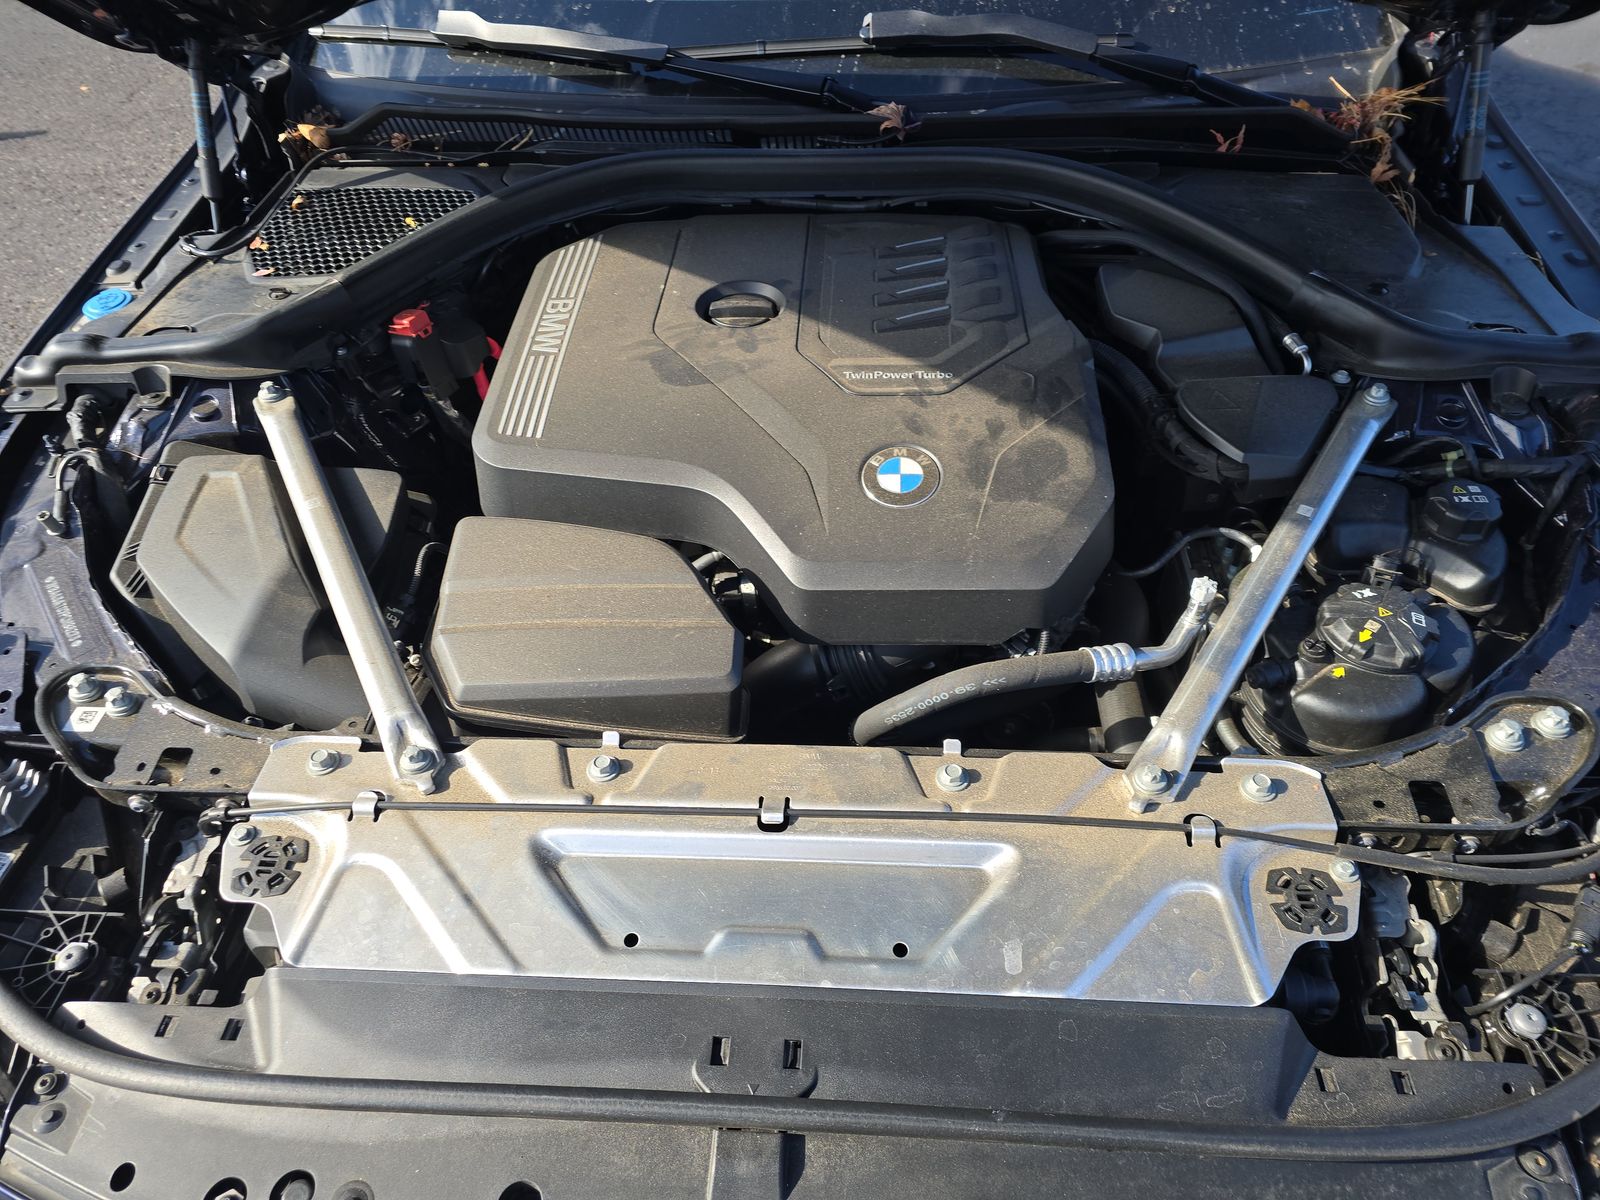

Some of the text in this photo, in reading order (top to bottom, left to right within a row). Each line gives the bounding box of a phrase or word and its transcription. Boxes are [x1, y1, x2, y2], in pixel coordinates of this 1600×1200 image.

[532, 299, 575, 353] BMW
[842, 370, 954, 380] TwinPower Turbo
[870, 448, 932, 467] BMW
